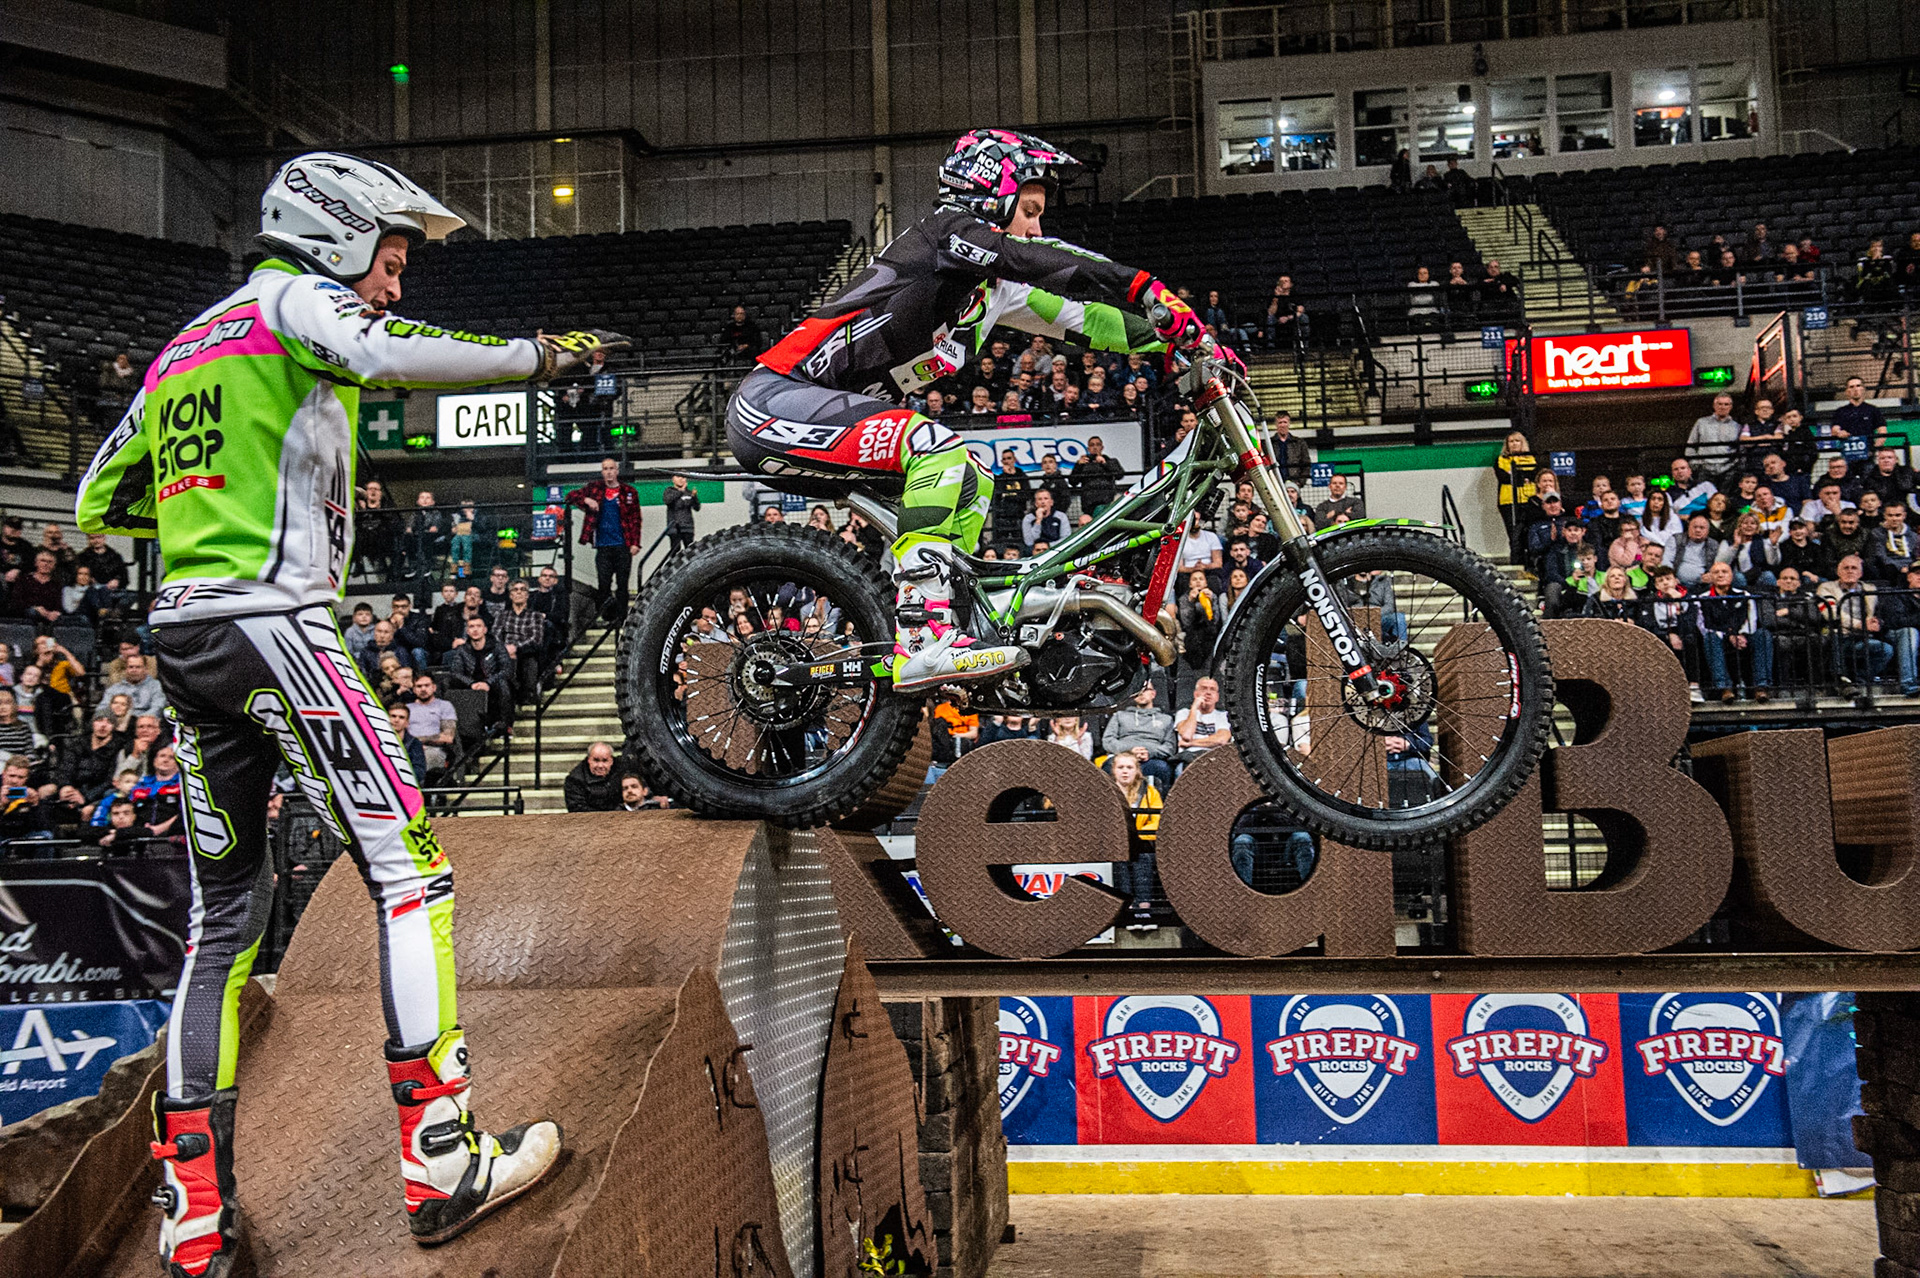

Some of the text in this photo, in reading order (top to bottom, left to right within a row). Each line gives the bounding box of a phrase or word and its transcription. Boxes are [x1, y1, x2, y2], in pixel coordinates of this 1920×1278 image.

[970, 162, 998, 181] STOP
[977, 152, 1003, 175] NON
[1806, 312, 1827, 321] 210
[1484, 331, 1501, 341] 211
[1545, 335, 1650, 377] heart
[597, 379, 614, 387] 212
[159, 384, 222, 440] NON
[858, 419, 881, 463] NON
[873, 418, 898, 461] STOP
[1844, 441, 1866, 451] 110
[159, 429, 225, 483] STOP
[1553, 457, 1574, 467] 110
[1313, 468, 1332, 478] 111
[162, 477, 210, 498] BIKES
[535, 519, 555, 529] 112
[1299, 567, 1360, 667] NONSTOP
[952, 650, 1006, 672] BUSTO
[11, 990, 90, 1002] LEASE
[1116, 1004, 1132, 1022] BAR
[1293, 1002, 1311, 1021] BAR
[1476, 1001, 1493, 1020] BAR
[1663, 1001, 1683, 1020] BAR
[1091, 1034, 1236, 1075] FIREPIT
[1269, 1032, 1417, 1073] FIREPIT
[1451, 1032, 1604, 1073] FIREPIT
[1142, 1061, 1188, 1073] ROCKS
[1320, 1061, 1368, 1072] ROCKS
[1504, 1061, 1552, 1072] ROCKS
[1694, 1061, 1745, 1072] ROCKS
[19, 1077, 68, 1093] Airport
[1135, 1083, 1158, 1106] RIFFS
[1175, 1083, 1194, 1105] JAMS
[1313, 1083, 1339, 1106] RIFFS
[1353, 1083, 1375, 1106] JAMS
[1498, 1083, 1522, 1106] RIFFS
[1540, 1084, 1560, 1106] JAMS
[1686, 1083, 1714, 1107] RIFFS
[1730, 1084, 1753, 1107] JAMS
